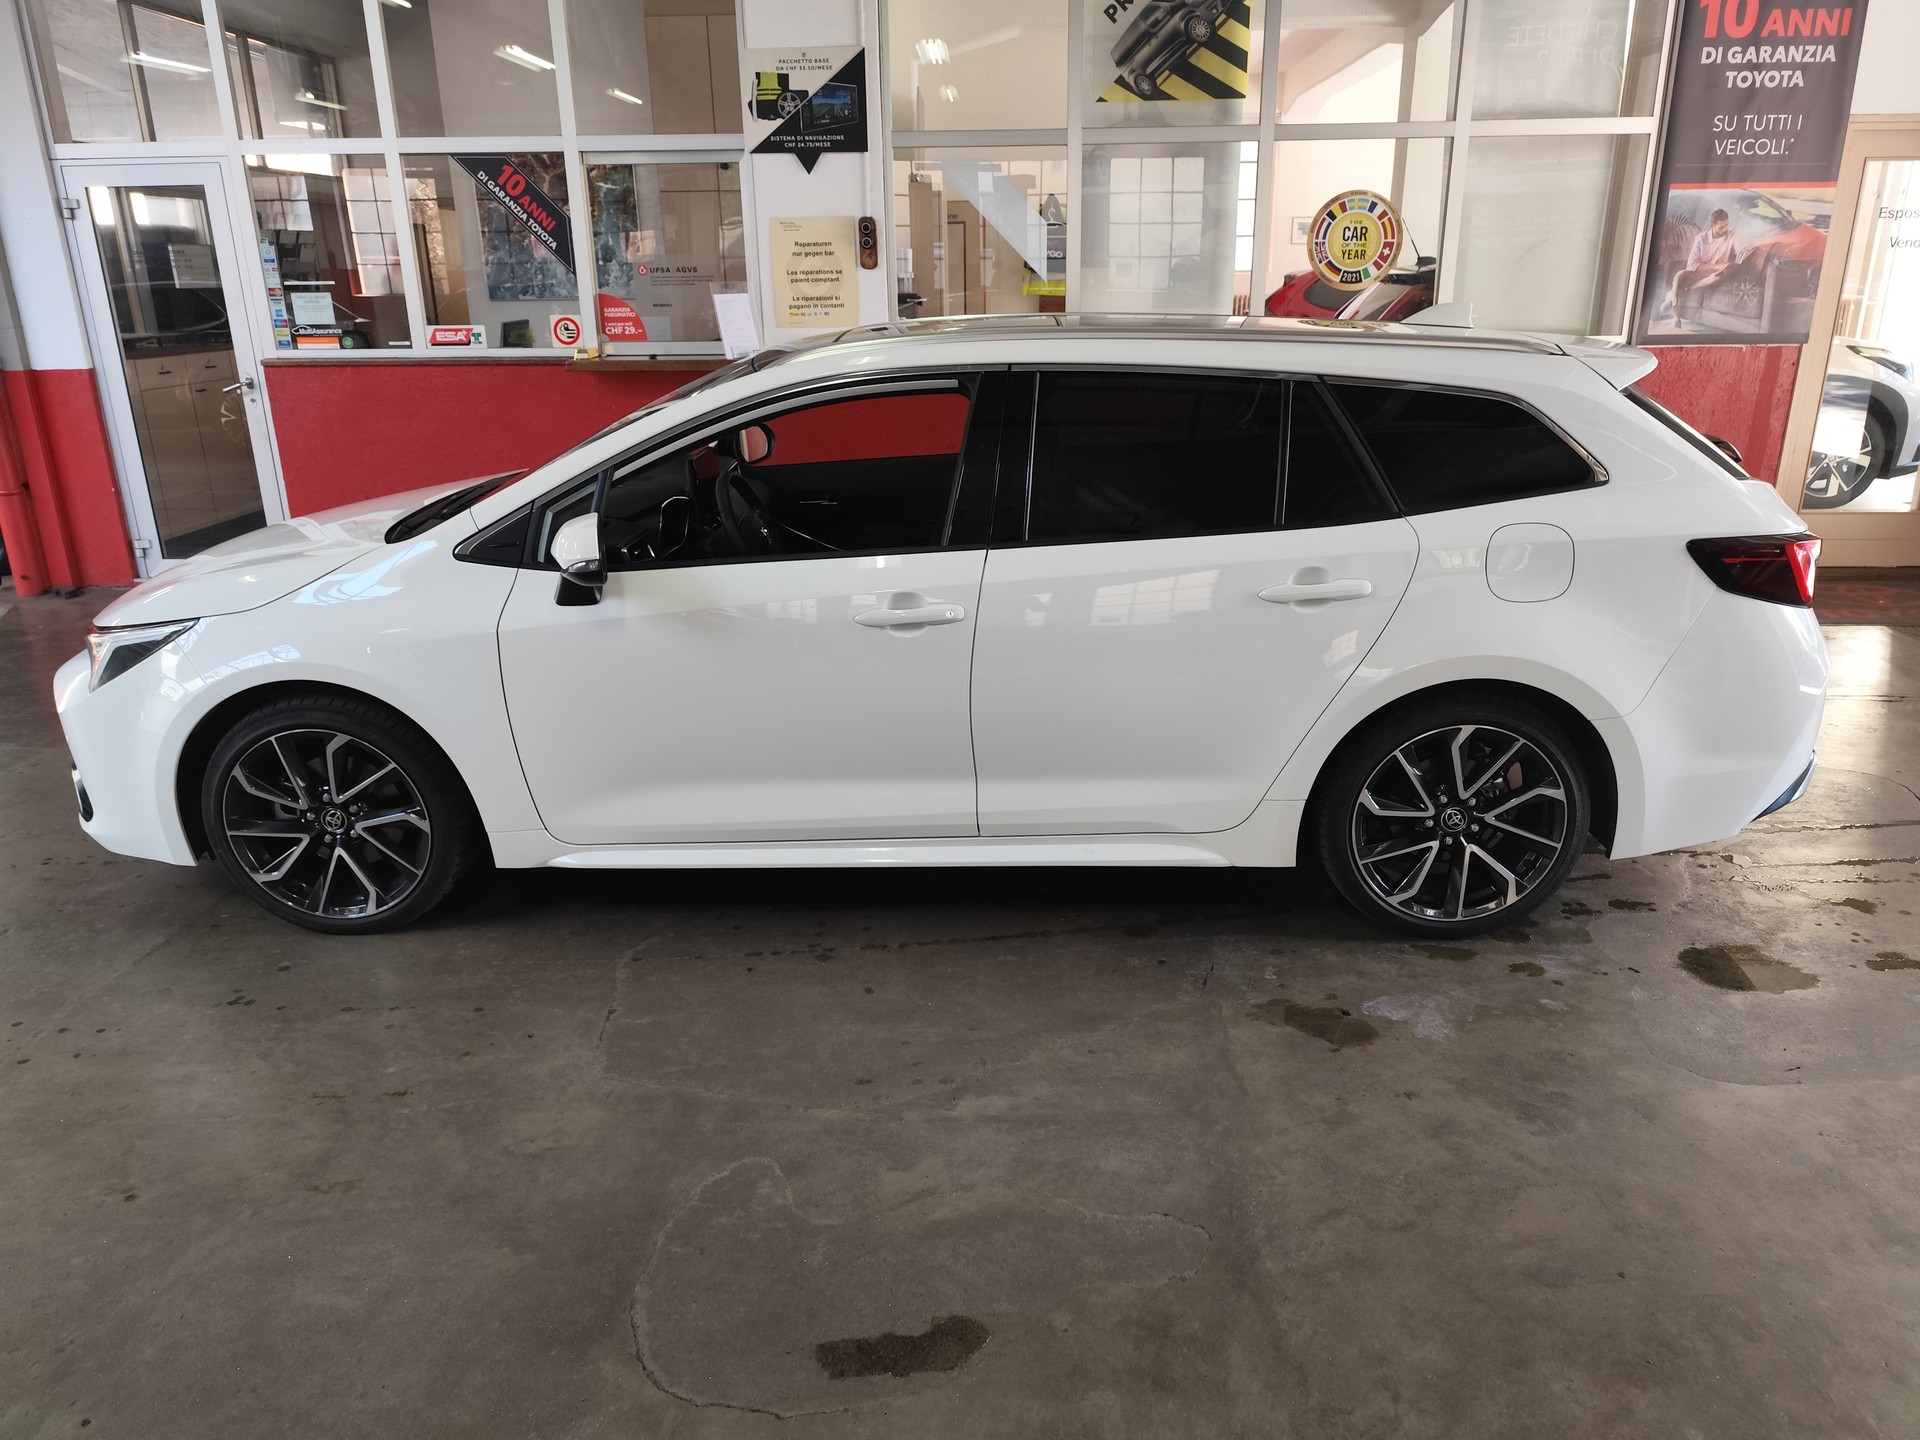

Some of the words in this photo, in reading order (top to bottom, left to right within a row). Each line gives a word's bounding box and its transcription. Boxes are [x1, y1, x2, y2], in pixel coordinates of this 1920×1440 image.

[1700, 0, 1760, 39] 10
[1760, 7, 1853, 37] ANNI
[1700, 46, 1723, 64] DI
[1727, 45, 1837, 64] GARANZIA
[1725, 70, 1804, 89] TOYOTA
[1712, 114, 1738, 131] SU
[1743, 114, 1792, 131] TUTTI
[1797, 114, 1803, 130] I
[497, 164, 526, 196] 10
[518, 195, 557, 232] ANNI
[477, 170, 488, 184] DI
[487, 180, 527, 222] GARANZIA
[527, 219, 557, 250] TOYOTA
[1342, 226, 1368, 242] CAR
[1341, 249, 1366, 260] YEAR
[1343, 273, 1360, 281] 2021
[801, 294, 833, 302] riparazioni
[605, 326, 623, 335] CHF
